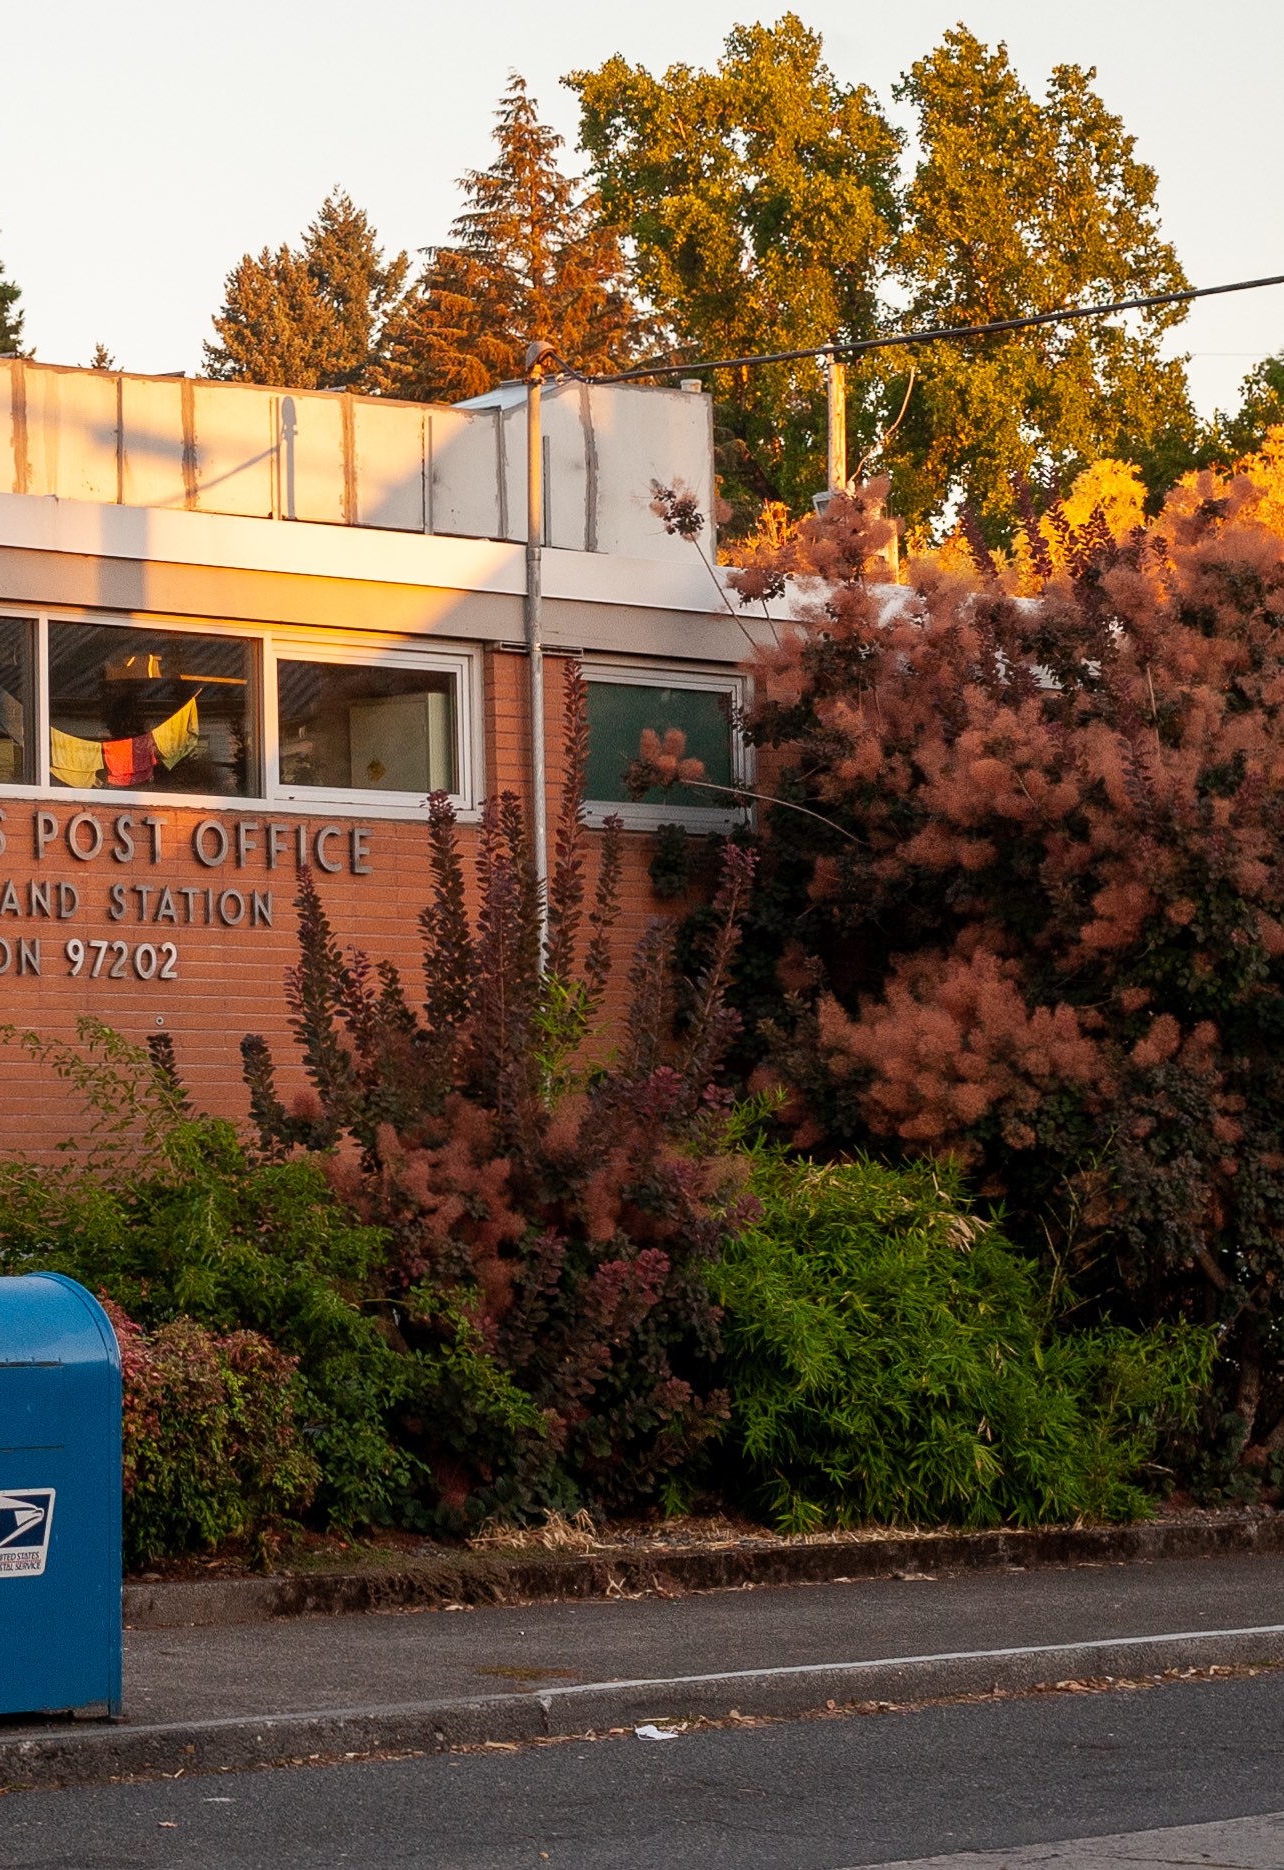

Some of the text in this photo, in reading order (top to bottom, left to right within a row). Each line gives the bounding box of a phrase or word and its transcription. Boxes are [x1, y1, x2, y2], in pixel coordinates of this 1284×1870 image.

[35, 811, 169, 865] POST
[194, 819, 374, 874] OFFICE
[110, 883, 273, 927] STATION
[65, 938, 179, 980] 97202
[15, 1562, 41, 1571] SERVICE
[17, 1551, 40, 1560] STATES
